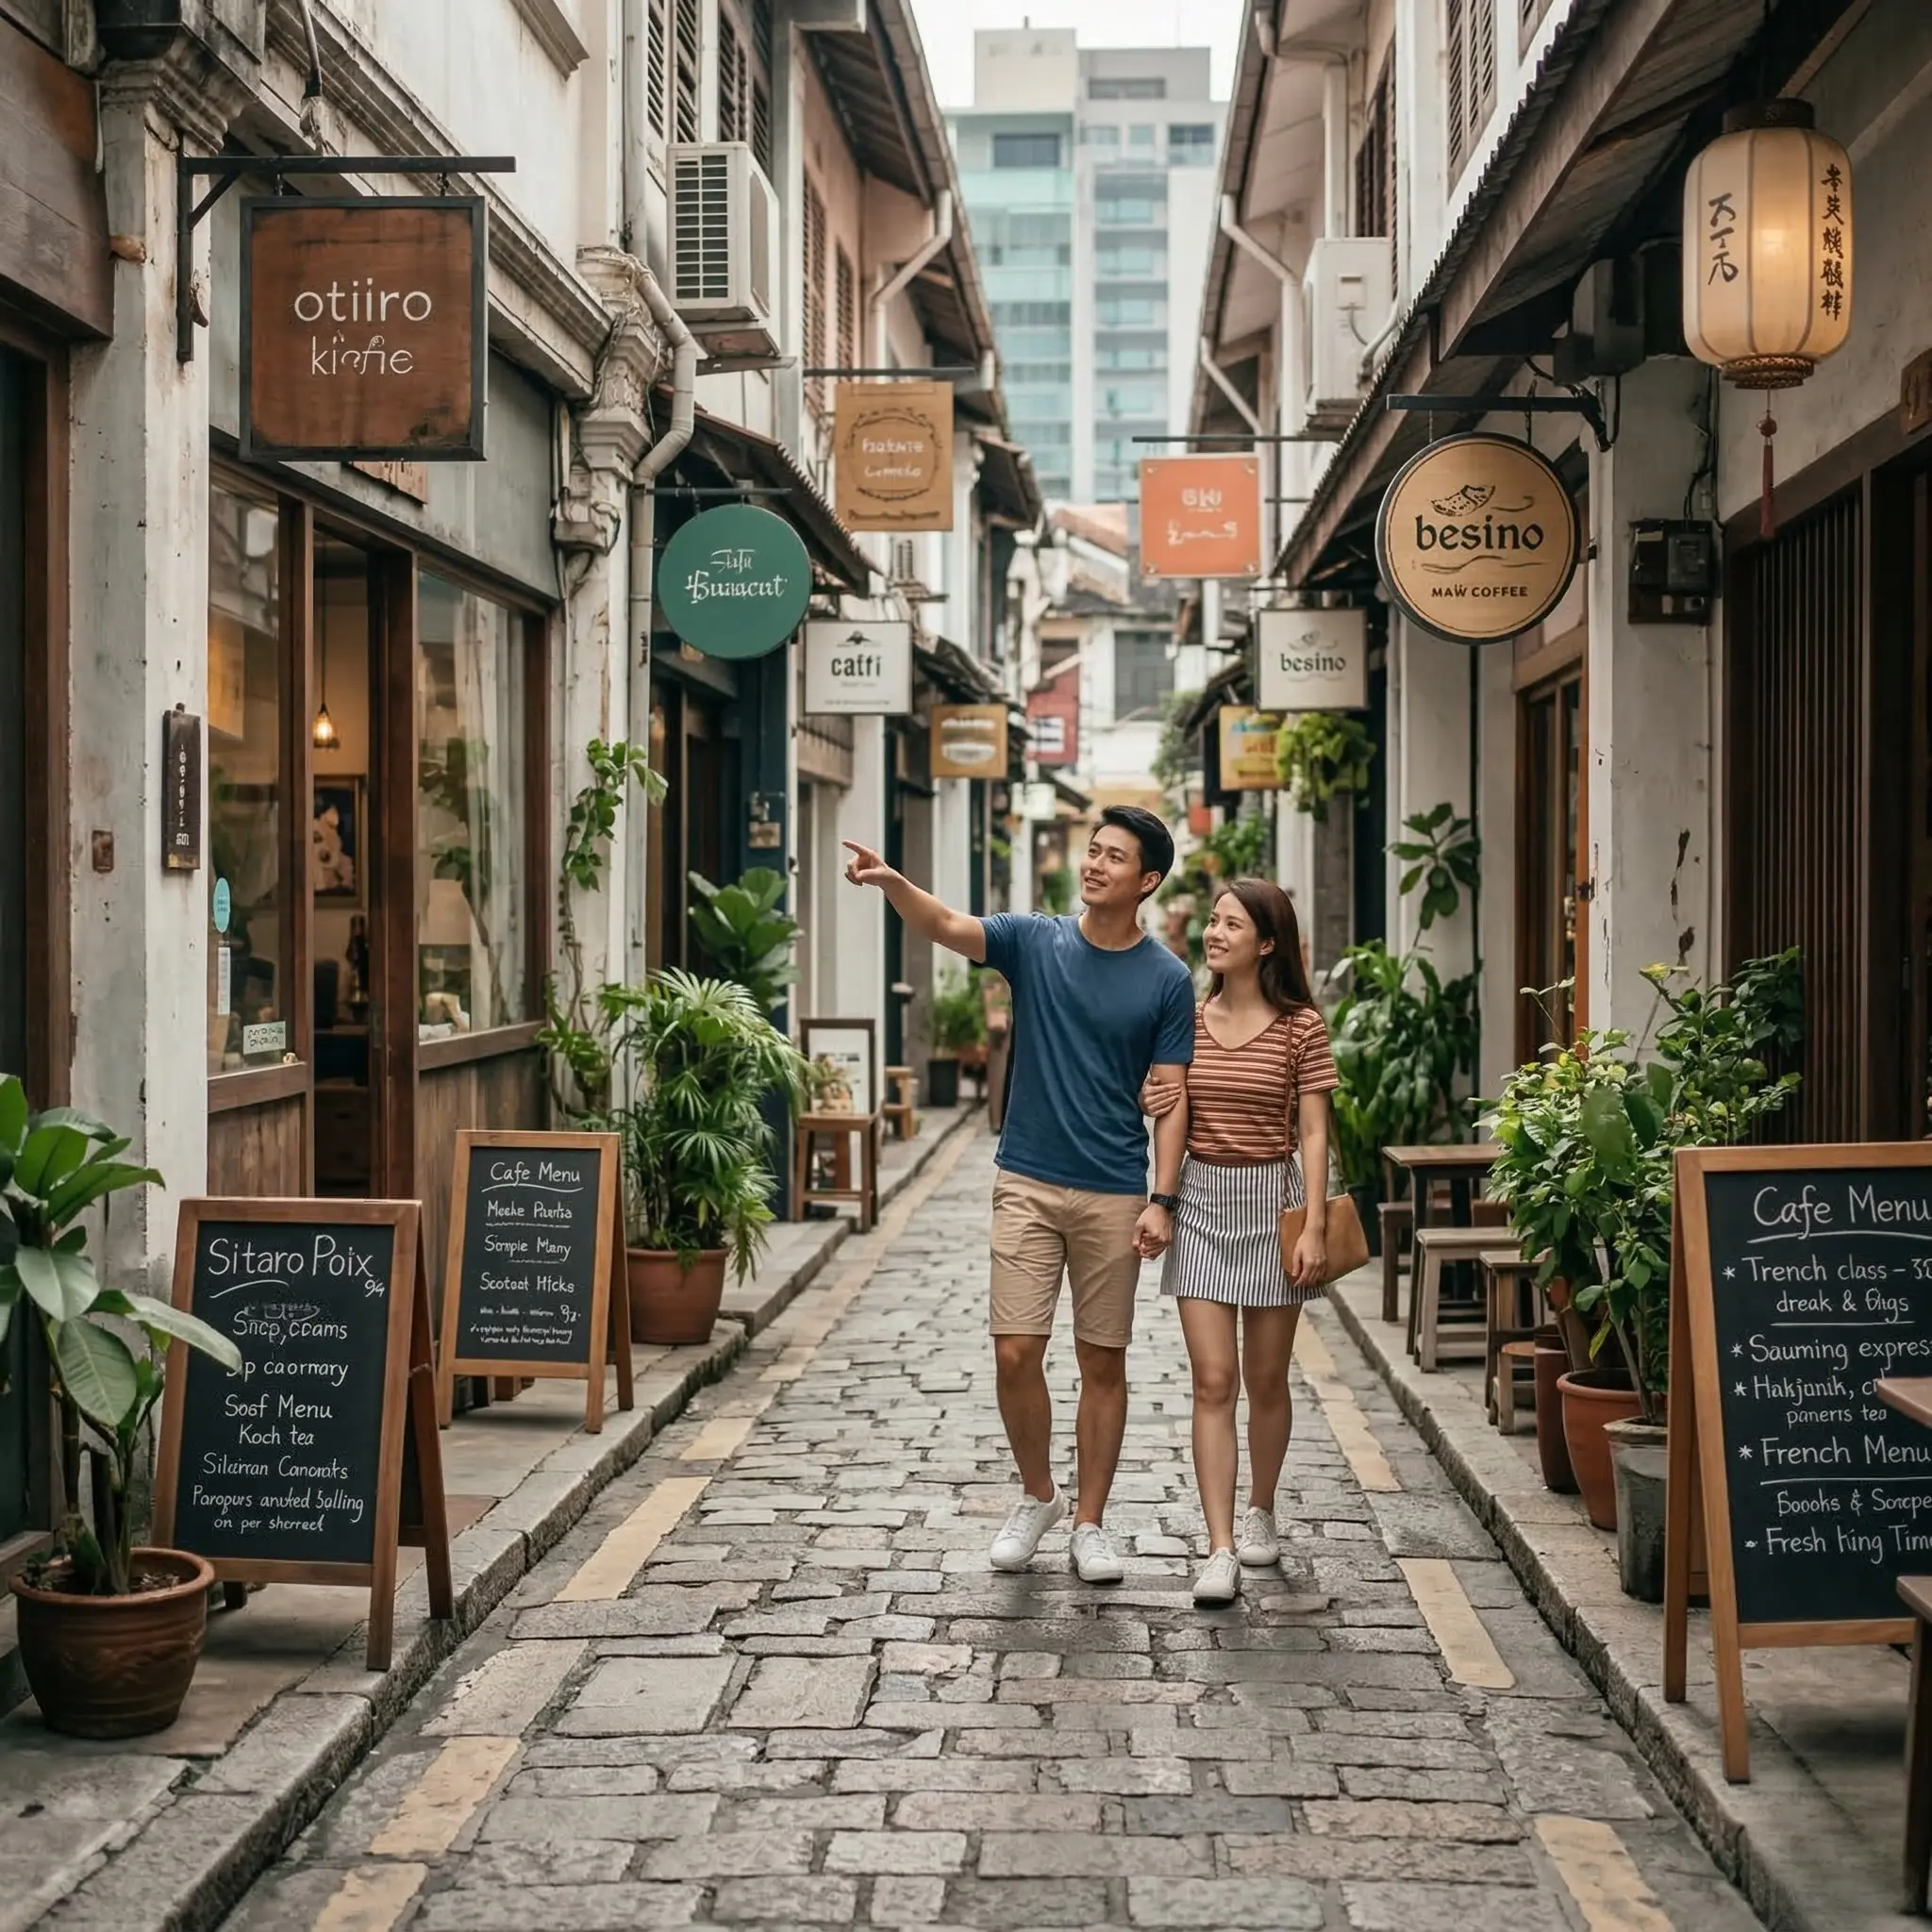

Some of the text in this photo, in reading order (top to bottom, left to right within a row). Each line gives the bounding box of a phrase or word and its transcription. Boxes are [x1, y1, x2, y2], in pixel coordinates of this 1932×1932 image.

[294, 277, 432, 322] otiiro
[1415, 514, 1544, 551] besino
[1472, 587, 1528, 598] COFFEE
[1280, 652, 1347, 672] besino
[491, 1161, 581, 1187] Cafe Menu
[1754, 1185, 1932, 1240] Cafe Menu
[208, 1234, 374, 1277] Sitaro Poix
[1741, 1254, 1827, 1281] Trench
[1775, 1290, 1833, 1312] dreak
[1842, 1289, 1857, 1311] &
[1749, 1333, 1849, 1371] Sauming
[278, 1394, 333, 1419] Menu
[1860, 1404, 1888, 1422] tea
[239, 1424, 315, 1445] Koch tea
[1760, 1435, 1931, 1466] French Menu
[213, 1518, 233, 1528] on
[240, 1519, 262, 1535] per
[1766, 1525, 1826, 1556] Fresh
